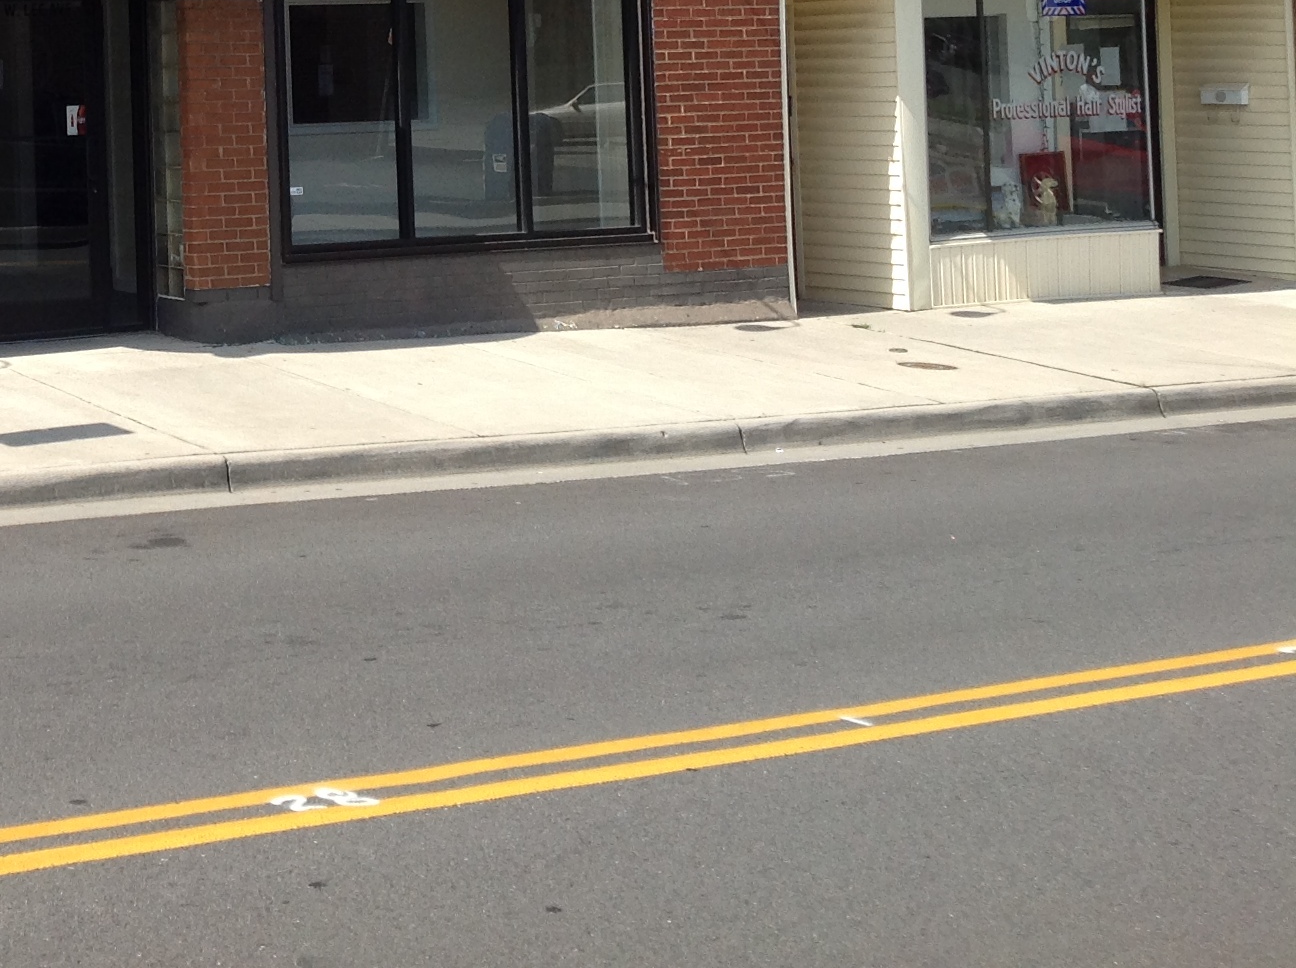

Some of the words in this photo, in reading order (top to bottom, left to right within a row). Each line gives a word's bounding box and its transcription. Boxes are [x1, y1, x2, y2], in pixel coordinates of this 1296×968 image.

[1027, 50, 1105, 85] VINTON'S
[992, 96, 1070, 120] Professional
[1076, 94, 1103, 118] Hair
[1108, 93, 1142, 120] Stylist
